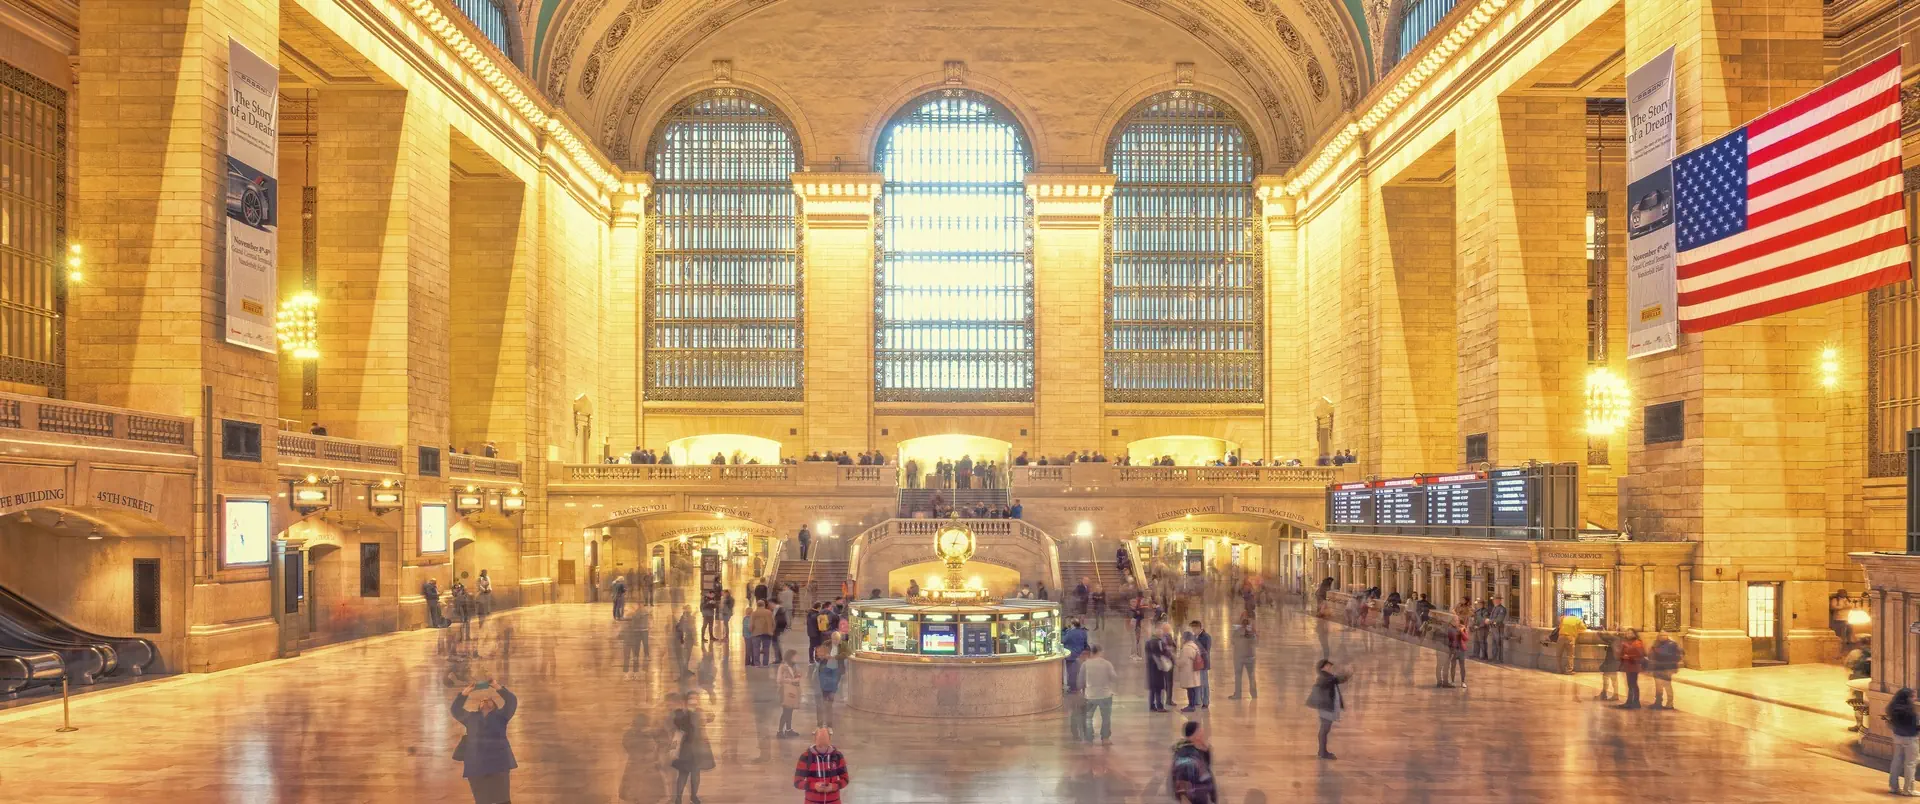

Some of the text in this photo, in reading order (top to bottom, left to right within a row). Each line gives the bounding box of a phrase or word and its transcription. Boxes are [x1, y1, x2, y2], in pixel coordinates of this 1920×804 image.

[234, 89, 272, 125] The Story
[1632, 100, 1670, 128] The Story
[231, 105, 274, 136] of a Dream
[1629, 113, 1672, 143] of a Dream
[234, 236, 258, 252] November
[244, 250, 257, 260] Central
[1632, 249, 1656, 262] November
[1643, 257, 1655, 268] Central
[15, 488, 64, 506] BUILDING
[97, 491, 154, 513] 45TH STREET
[613, 507, 640, 517] TRACKS
[693, 504, 736, 515] LEXINGTON
[1158, 507, 1200, 519] LEXINGTON
[1268, 508, 1305, 521] MACHINES
